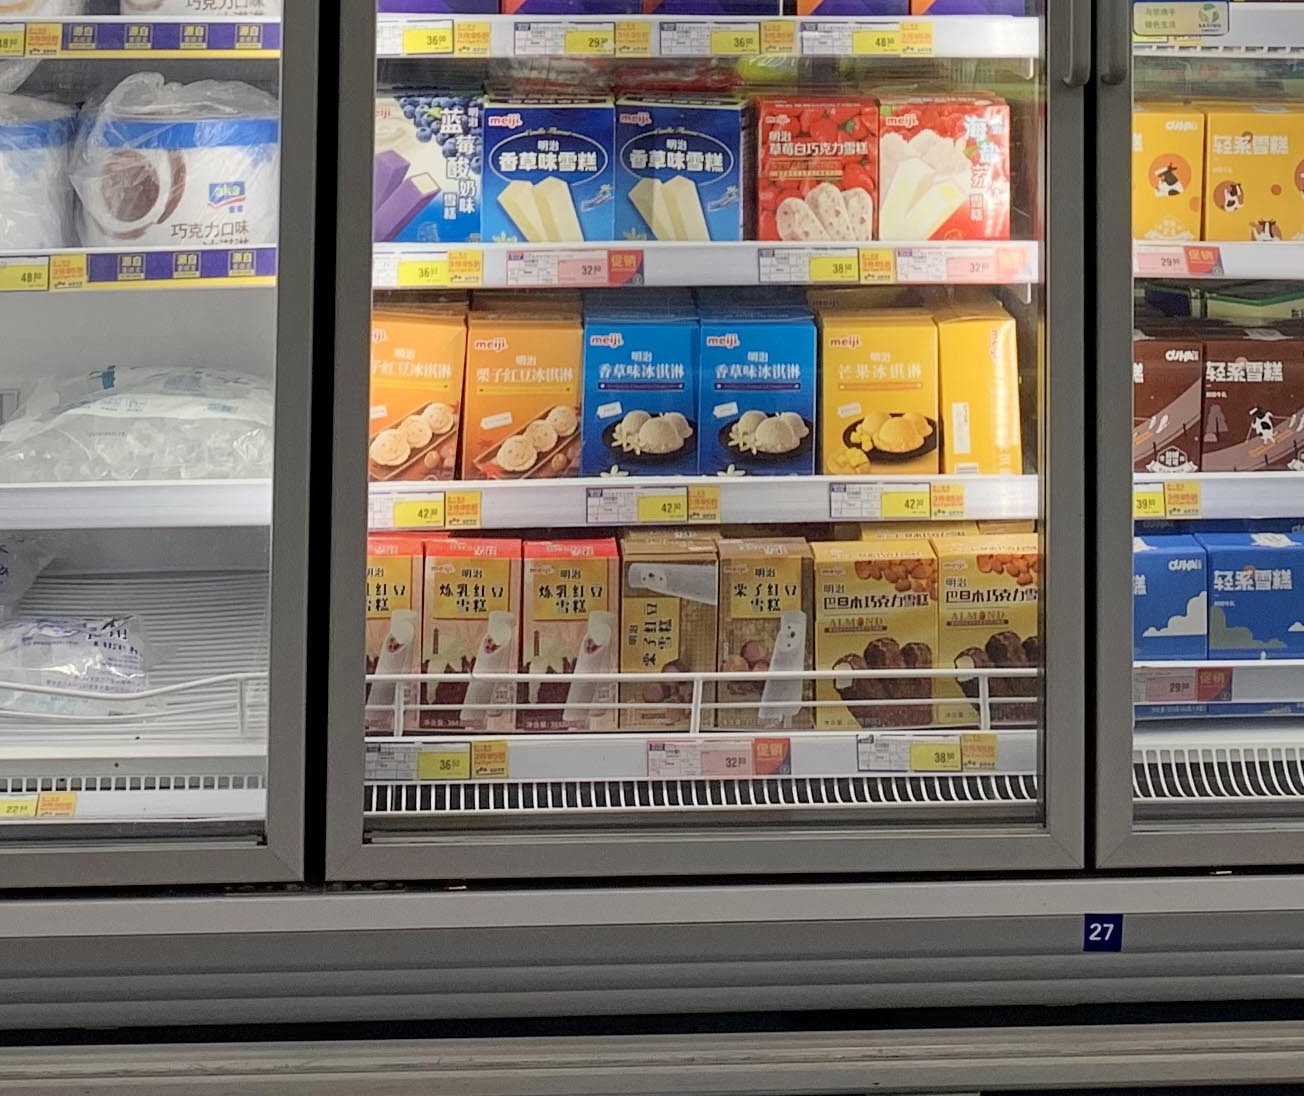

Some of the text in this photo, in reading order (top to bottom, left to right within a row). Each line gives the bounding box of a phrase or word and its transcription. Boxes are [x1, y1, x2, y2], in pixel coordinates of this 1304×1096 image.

[488, 115, 519, 127] meiji
[620, 114, 649, 125] meiji
[886, 116, 917, 127] meiji
[769, 131, 792, 143] 明治
[537, 140, 560, 151] 明治
[666, 139, 688, 150] 明治
[768, 142, 868, 156] 草莓白巧克力雪糕
[499, 153, 598, 172] 香草味雪糕
[630, 150, 724, 172] 香草味雪糕
[171, 222, 248, 237] 巧克力口味
[611, 253, 635, 268] 促销
[474, 339, 506, 352] meiji
[591, 334, 621, 347] meiji
[707, 335, 737, 348] meiji
[830, 336, 860, 348] meiji
[515, 355, 536, 366] 明治
[631, 351, 652, 362] 明治
[747, 352, 768, 363] 明治
[476, 368, 574, 383] 栗子红豆冰淇淋
[599, 363, 684, 379] 香草味冰淇淋
[715, 365, 800, 380] 香草味冰淇淋
[839, 364, 922, 380] 芒果冰淇淋
[1205, 360, 1285, 383] 轻系雪糕
[462, 568, 483, 579] 明治
[560, 568, 582, 579] 明治
[1213, 569, 1293, 592] 轻系雪糕
[440, 583, 503, 598] 炼乳红豆
[539, 584, 603, 599] 炼乳红豆
[734, 583, 797, 597] 栗子红豆
[824, 583, 844, 594] 明治
[456, 599, 487, 613] 雪糕
[556, 599, 587, 614] 雪糕
[750, 598, 781, 612] 雪糕
[823, 594, 929, 609] 巴旦木巧克力雪糕
[1089, 923, 1114, 941] 27
